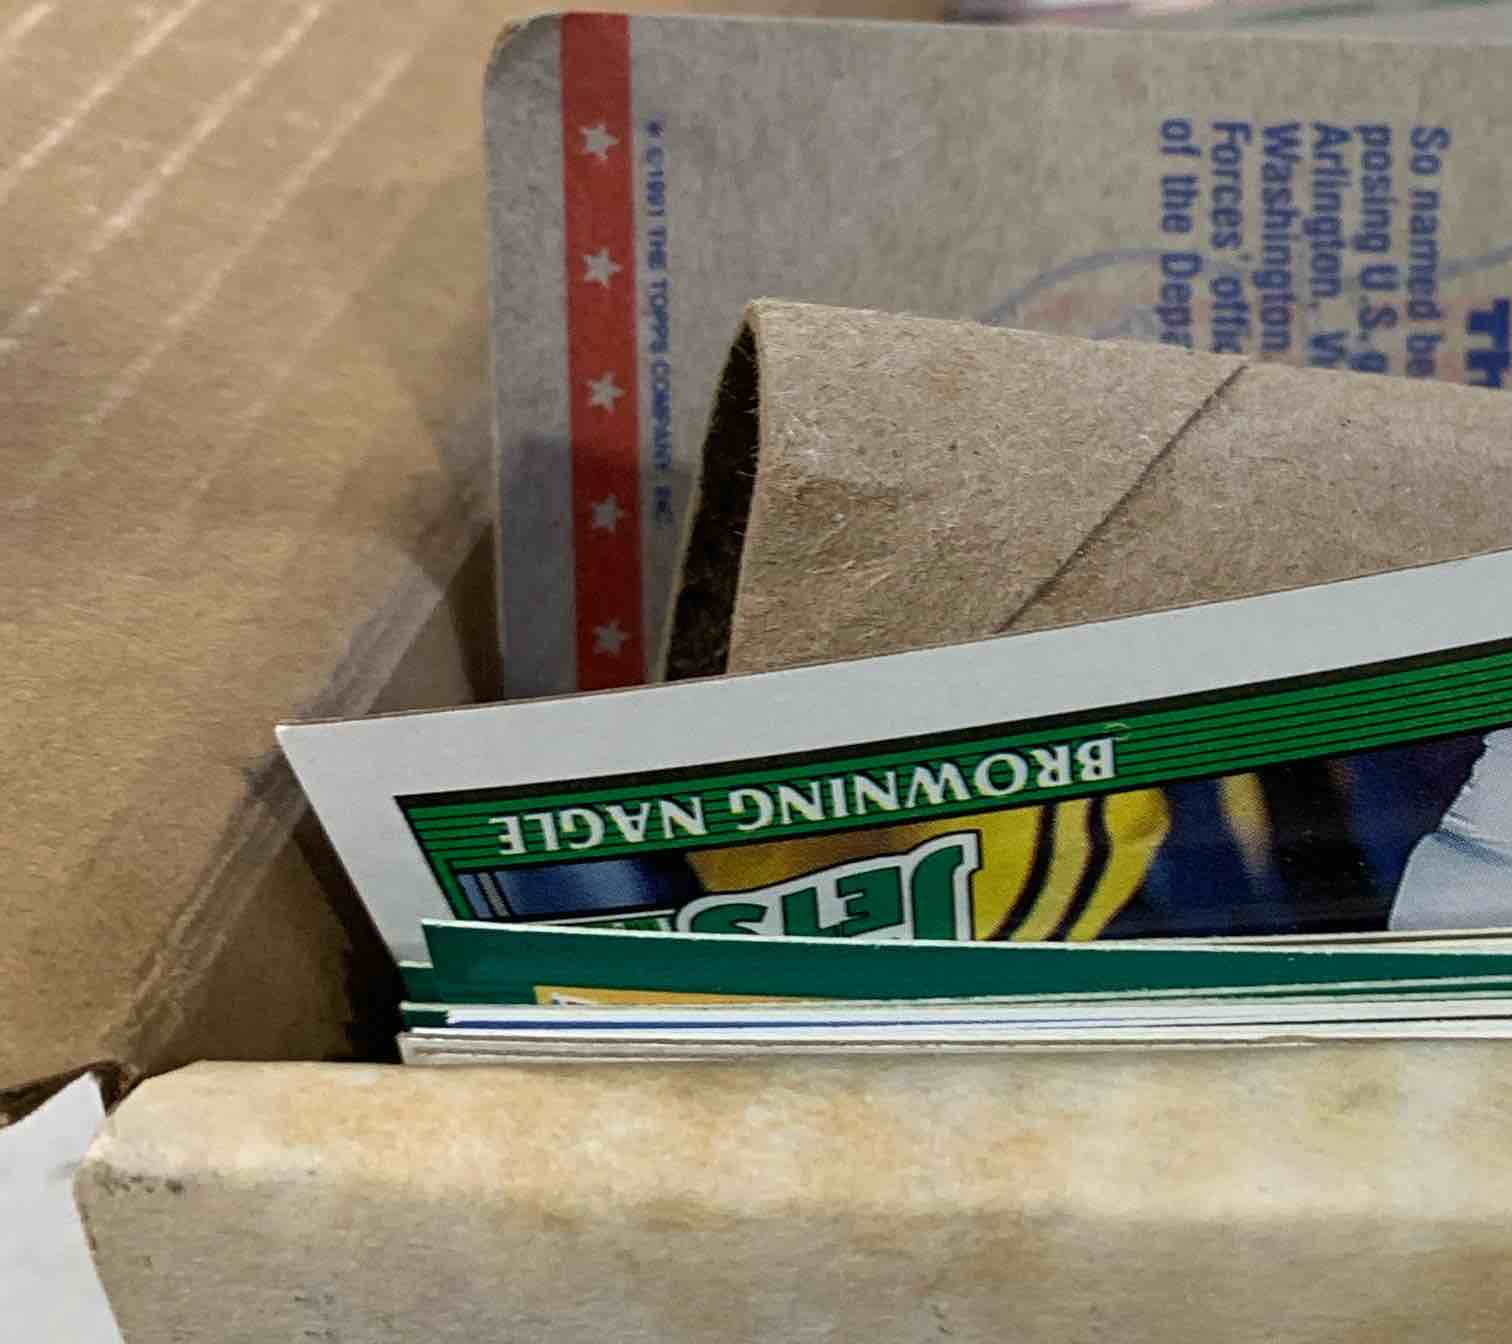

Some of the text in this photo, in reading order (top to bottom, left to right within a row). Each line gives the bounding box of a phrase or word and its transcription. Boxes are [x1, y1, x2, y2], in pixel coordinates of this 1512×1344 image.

[1160, 118, 1202, 155] of
[1409, 127, 1451, 175] So
[1160, 174, 1199, 234] the
[1353, 125, 1393, 253] posing
[648, 225, 668, 270] THE
[1406, 191, 1443, 320] named
[650, 277, 671, 352] TOPPS
[488, 736, 1116, 855] BROWNING NAGLE
